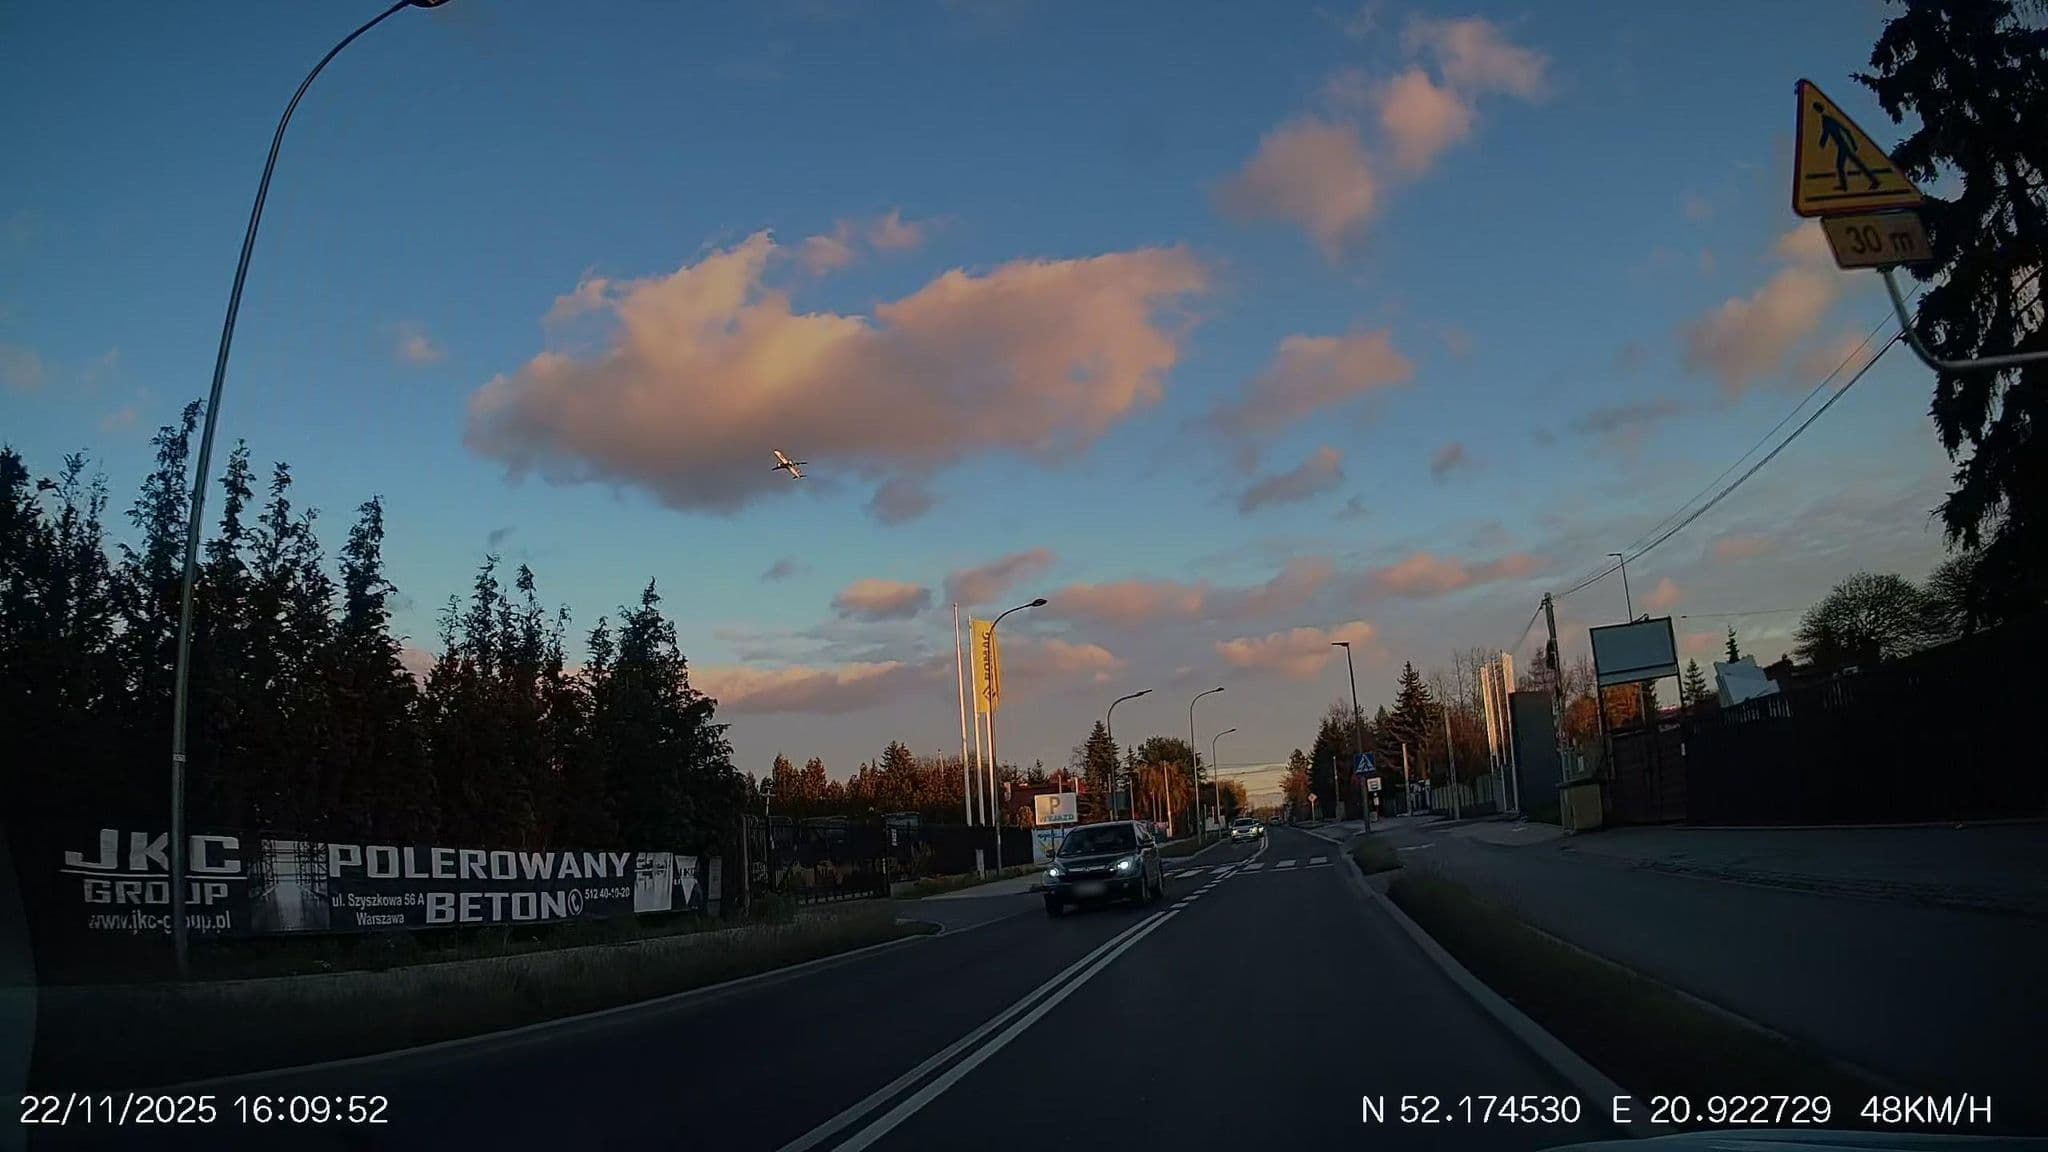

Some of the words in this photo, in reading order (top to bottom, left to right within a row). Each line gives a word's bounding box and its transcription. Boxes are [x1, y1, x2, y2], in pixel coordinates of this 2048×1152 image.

[1845, 225, 1882, 254] 30
[1888, 231, 1914, 252] m
[1049, 797, 1061, 814] P
[64, 828, 242, 873] JKC
[328, 843, 632, 880] POLEROWANY
[332, 893, 346, 907] ul.
[347, 893, 403, 911] Szyszkowa
[404, 892, 416, 906] 56
[417, 892, 425, 906] A
[584, 888, 599, 900] 512
[356, 911, 405, 926] Warszawa
[426, 891, 567, 924] BETON
